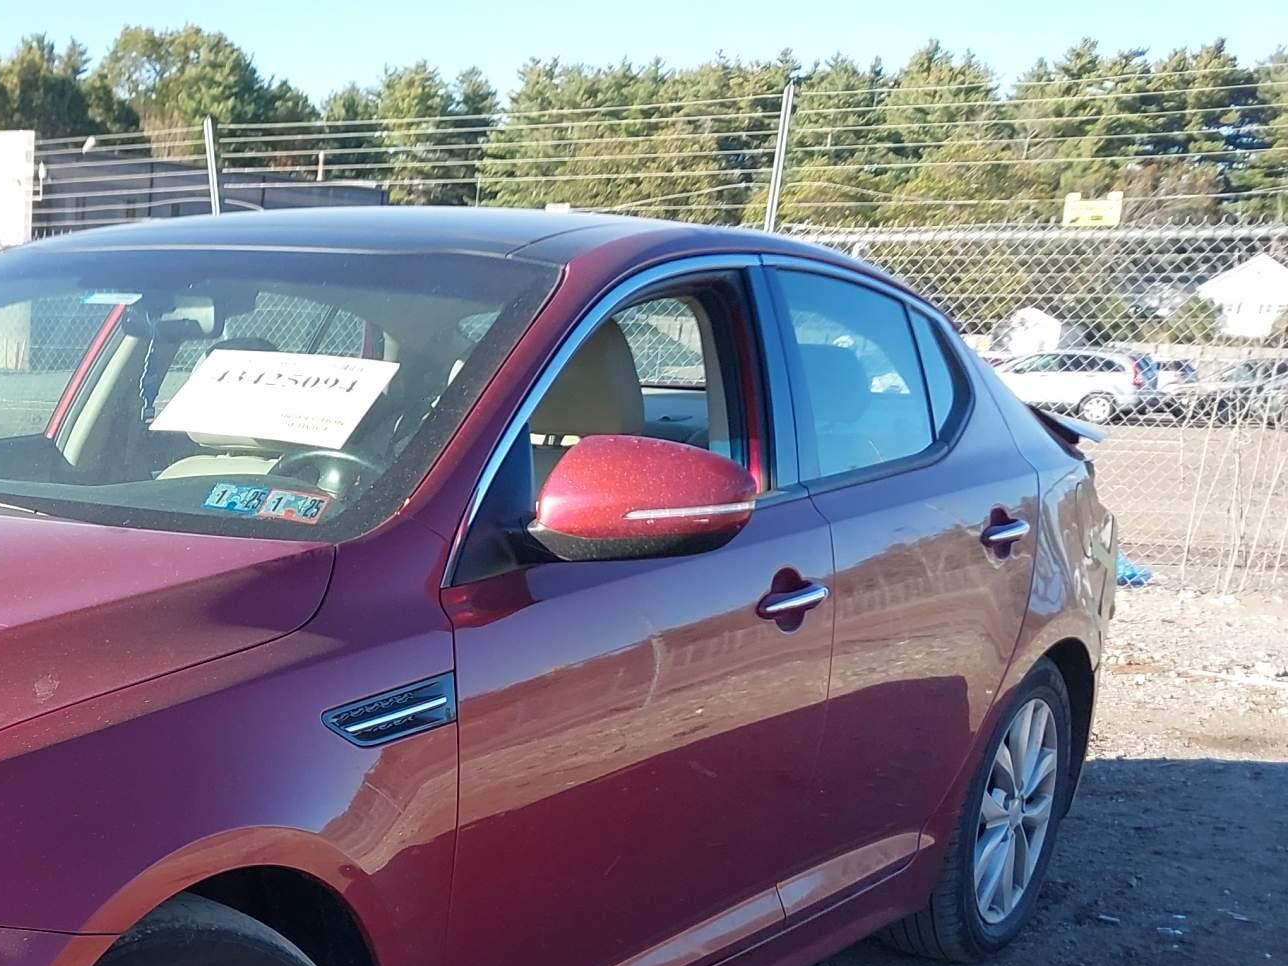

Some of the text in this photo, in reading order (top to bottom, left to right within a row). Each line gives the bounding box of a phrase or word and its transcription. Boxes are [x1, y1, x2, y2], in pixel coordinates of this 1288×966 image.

[216, 490, 266, 509] 1 25
[272, 497, 325, 518] 1 25
